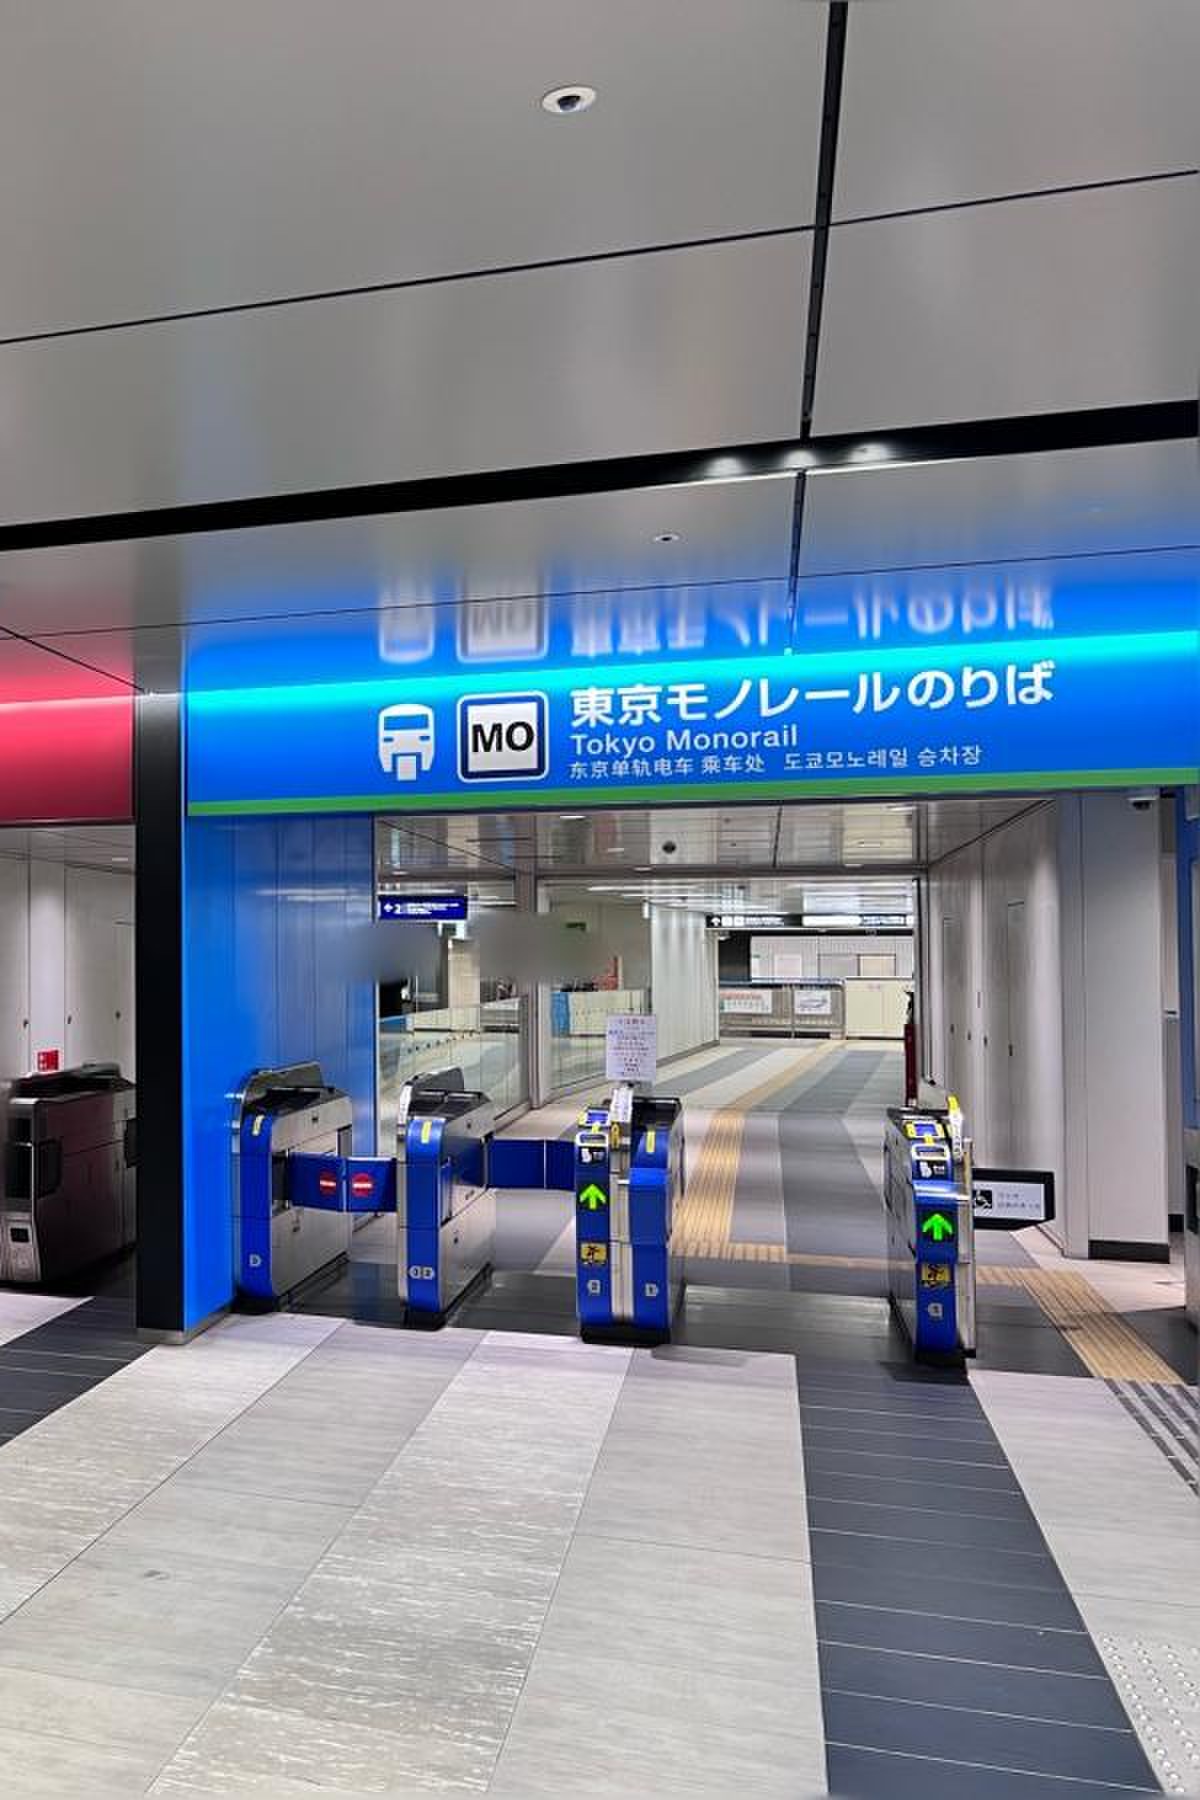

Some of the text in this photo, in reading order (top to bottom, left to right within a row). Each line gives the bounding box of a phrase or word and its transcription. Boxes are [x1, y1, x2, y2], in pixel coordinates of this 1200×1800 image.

[569, 660, 1056, 728] 東京モノレールのりば
[471, 721, 534, 753] MO
[569, 724, 798, 759] Tokyo Monorail
[568, 754, 766, 779] 东京单轨电车 乘车处
[783, 745, 983, 771] 도쿄모노레일 승차장
